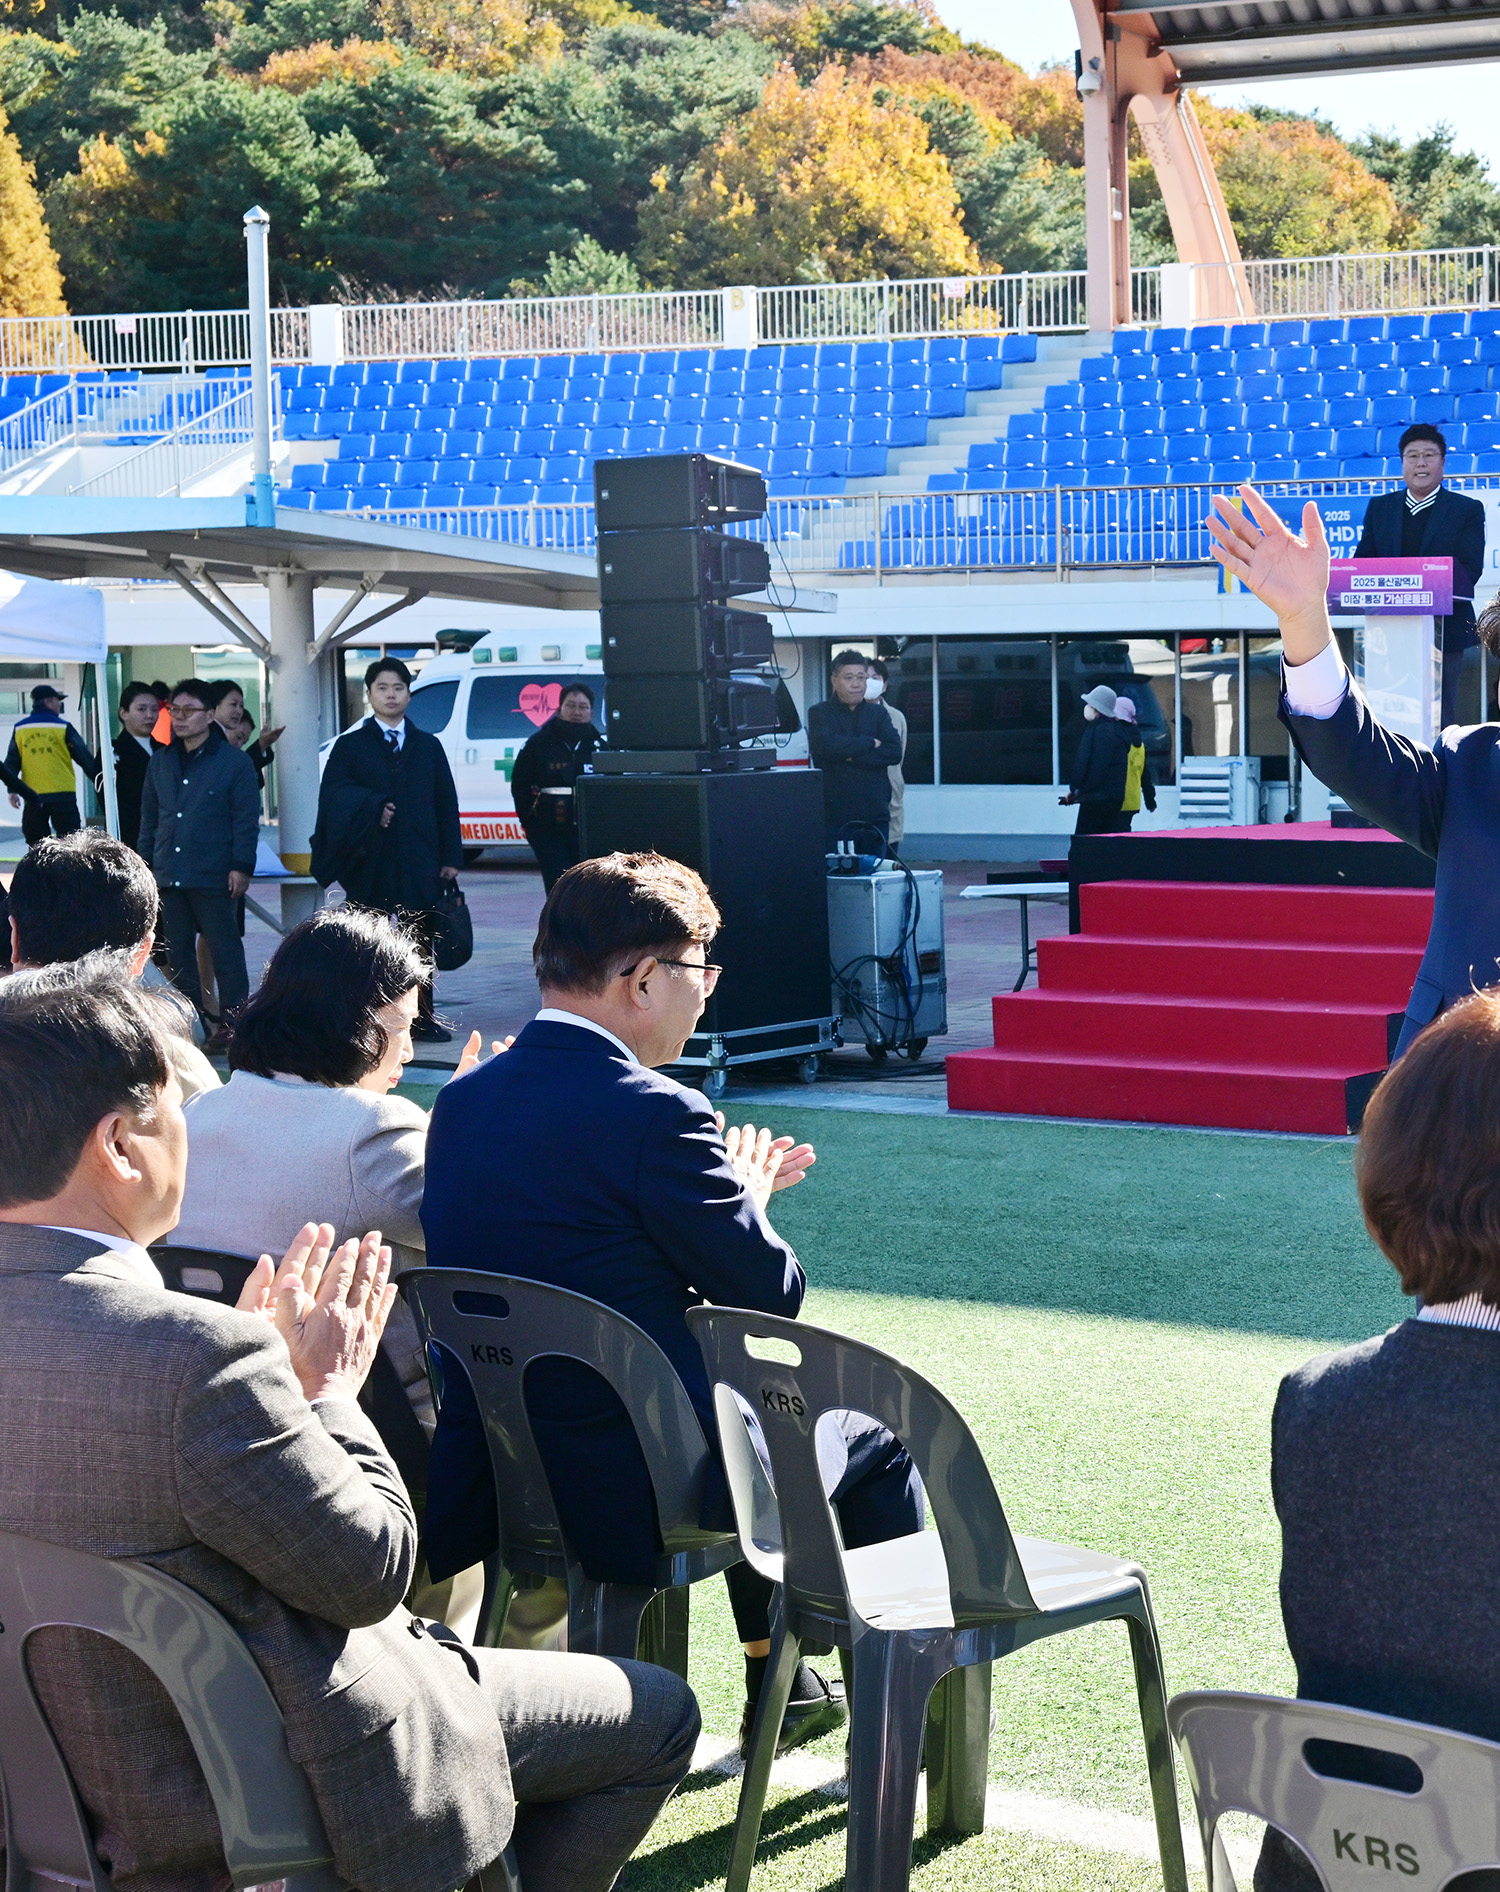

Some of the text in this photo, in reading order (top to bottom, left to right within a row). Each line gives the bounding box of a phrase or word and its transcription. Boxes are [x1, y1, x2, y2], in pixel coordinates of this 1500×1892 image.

[731, 288, 744, 311] B
[1324, 510, 1351, 522] 2025
[1353, 576, 1420, 587] 2025 울산광역시
[470, 1344, 514, 1367] KRS
[761, 1389, 805, 1417] KRS
[1333, 1828, 1421, 1878] KRS
